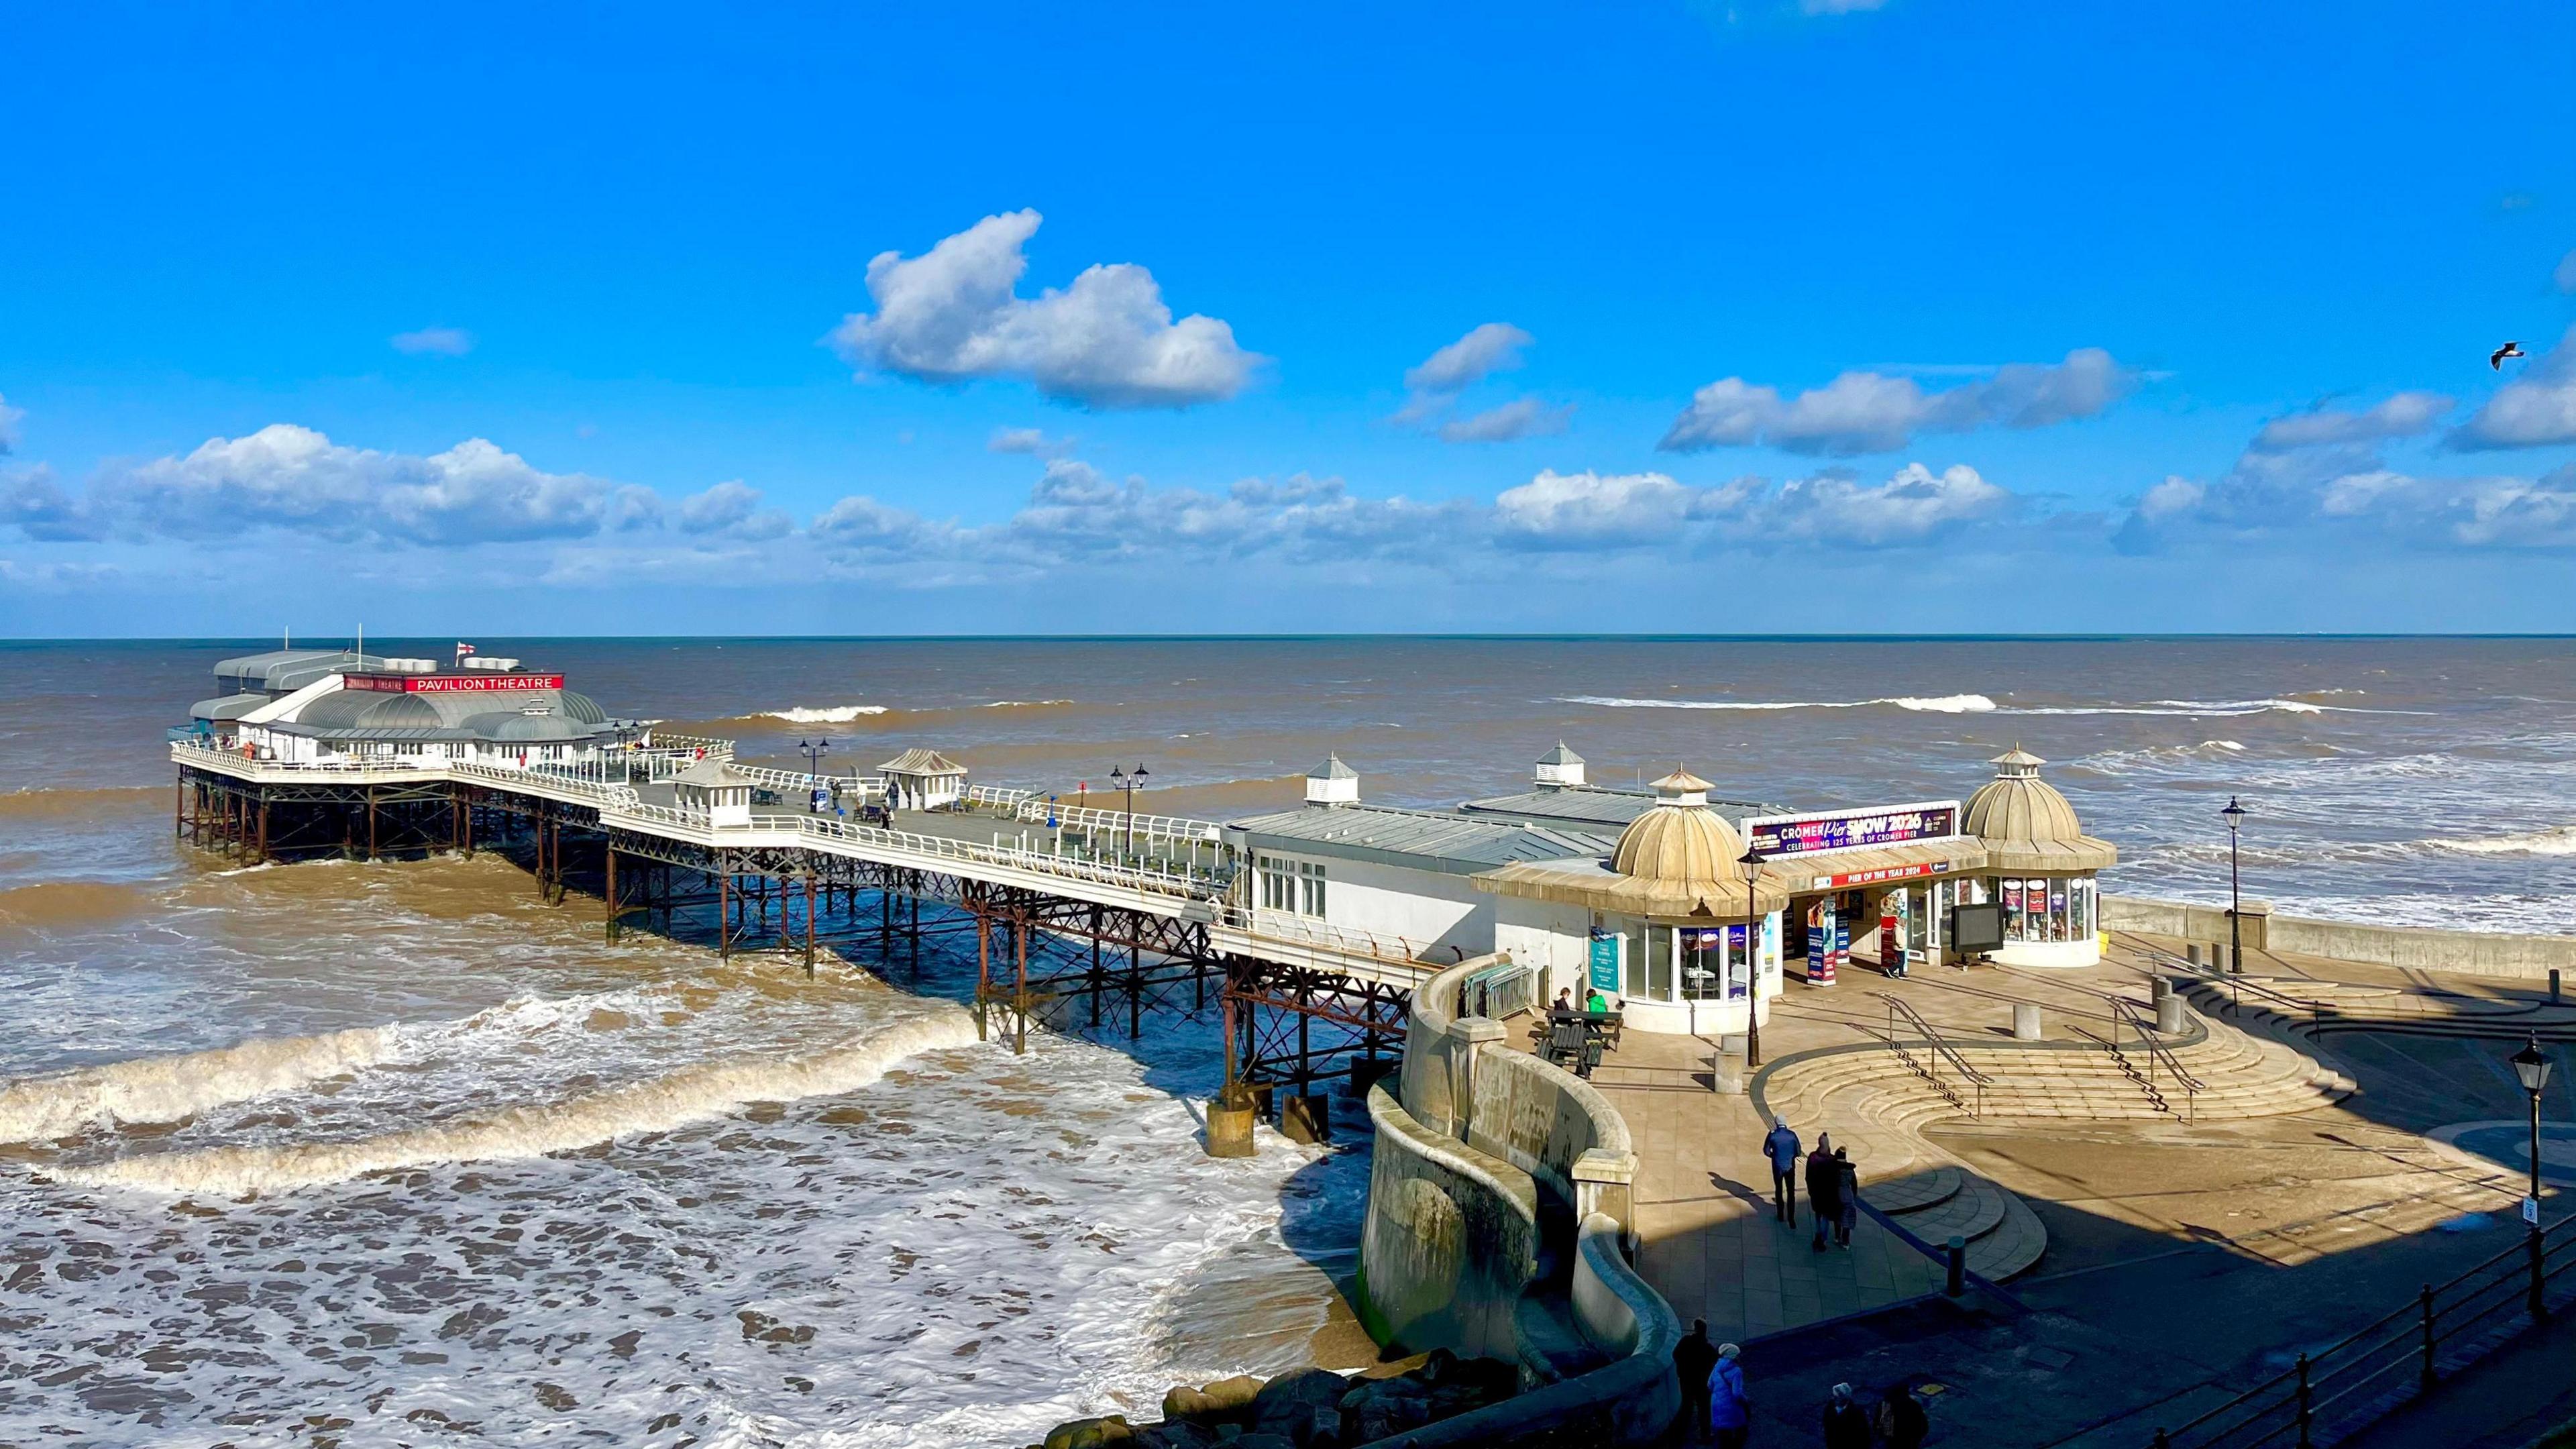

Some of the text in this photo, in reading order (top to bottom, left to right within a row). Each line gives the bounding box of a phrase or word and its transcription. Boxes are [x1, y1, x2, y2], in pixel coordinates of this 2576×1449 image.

[417, 678, 553, 690] PAVILION THEATRE
[1781, 813, 1922, 839] CROMER Pier SHOW 2026
[1786, 840, 1829, 851] CELEBRATING
[1833, 838, 1843, 847] 125
[1867, 834, 1875, 843] OF
[1878, 831, 1902, 841] CROMER
[1904, 830, 1917, 839] PIER
[1848, 866, 1921, 883] PIER OF THE YEAR 2024
